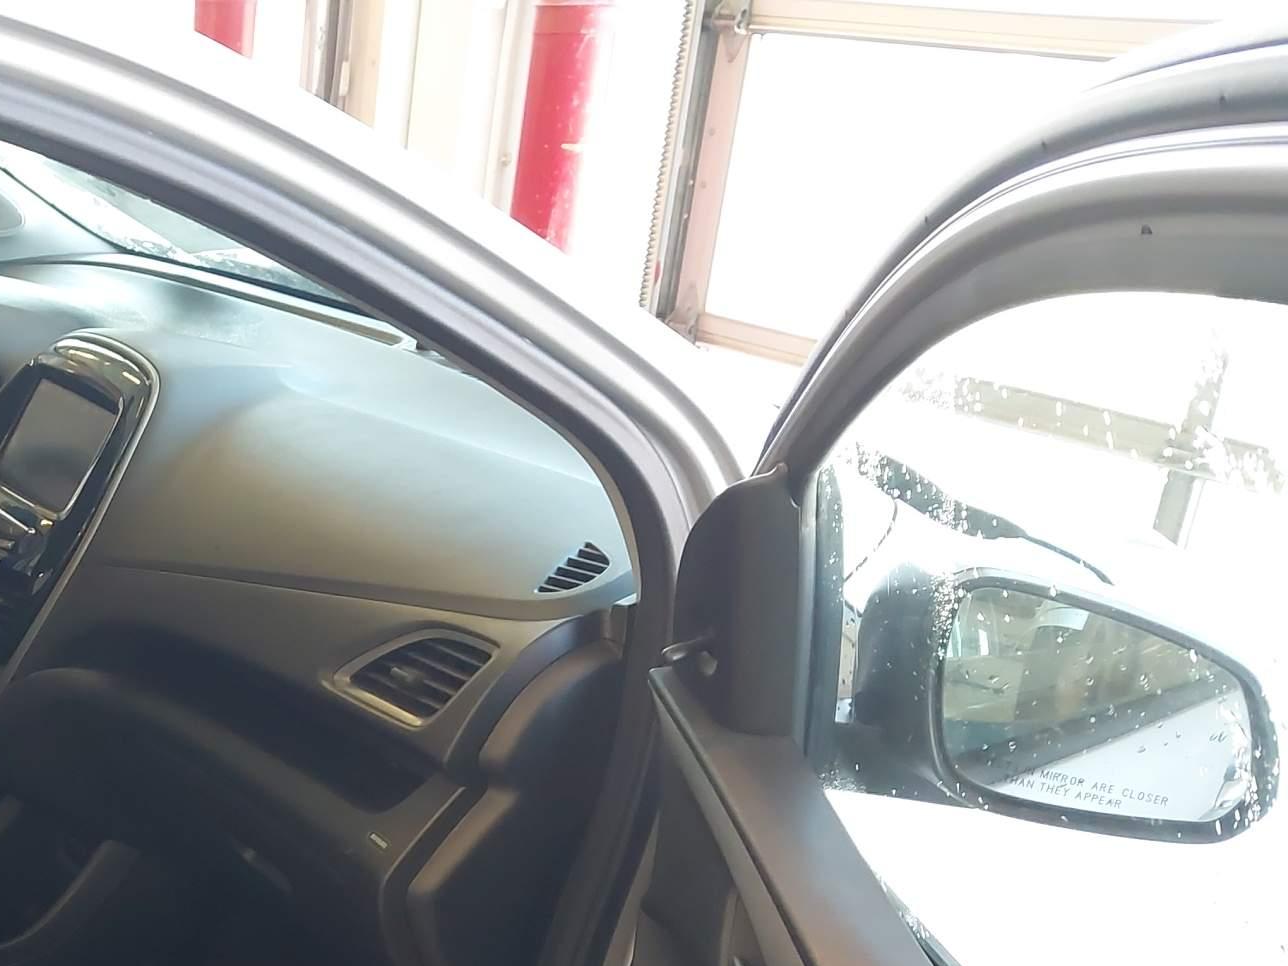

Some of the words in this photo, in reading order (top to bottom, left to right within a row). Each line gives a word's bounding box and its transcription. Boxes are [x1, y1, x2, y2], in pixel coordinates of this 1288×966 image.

[1040, 770, 1085, 787] MIRROR
[1091, 781, 1115, 794] ARE
[1121, 787, 1169, 809] CLOSER
[1040, 782, 1071, 797] THEY
[1074, 791, 1122, 809] APPEAR
